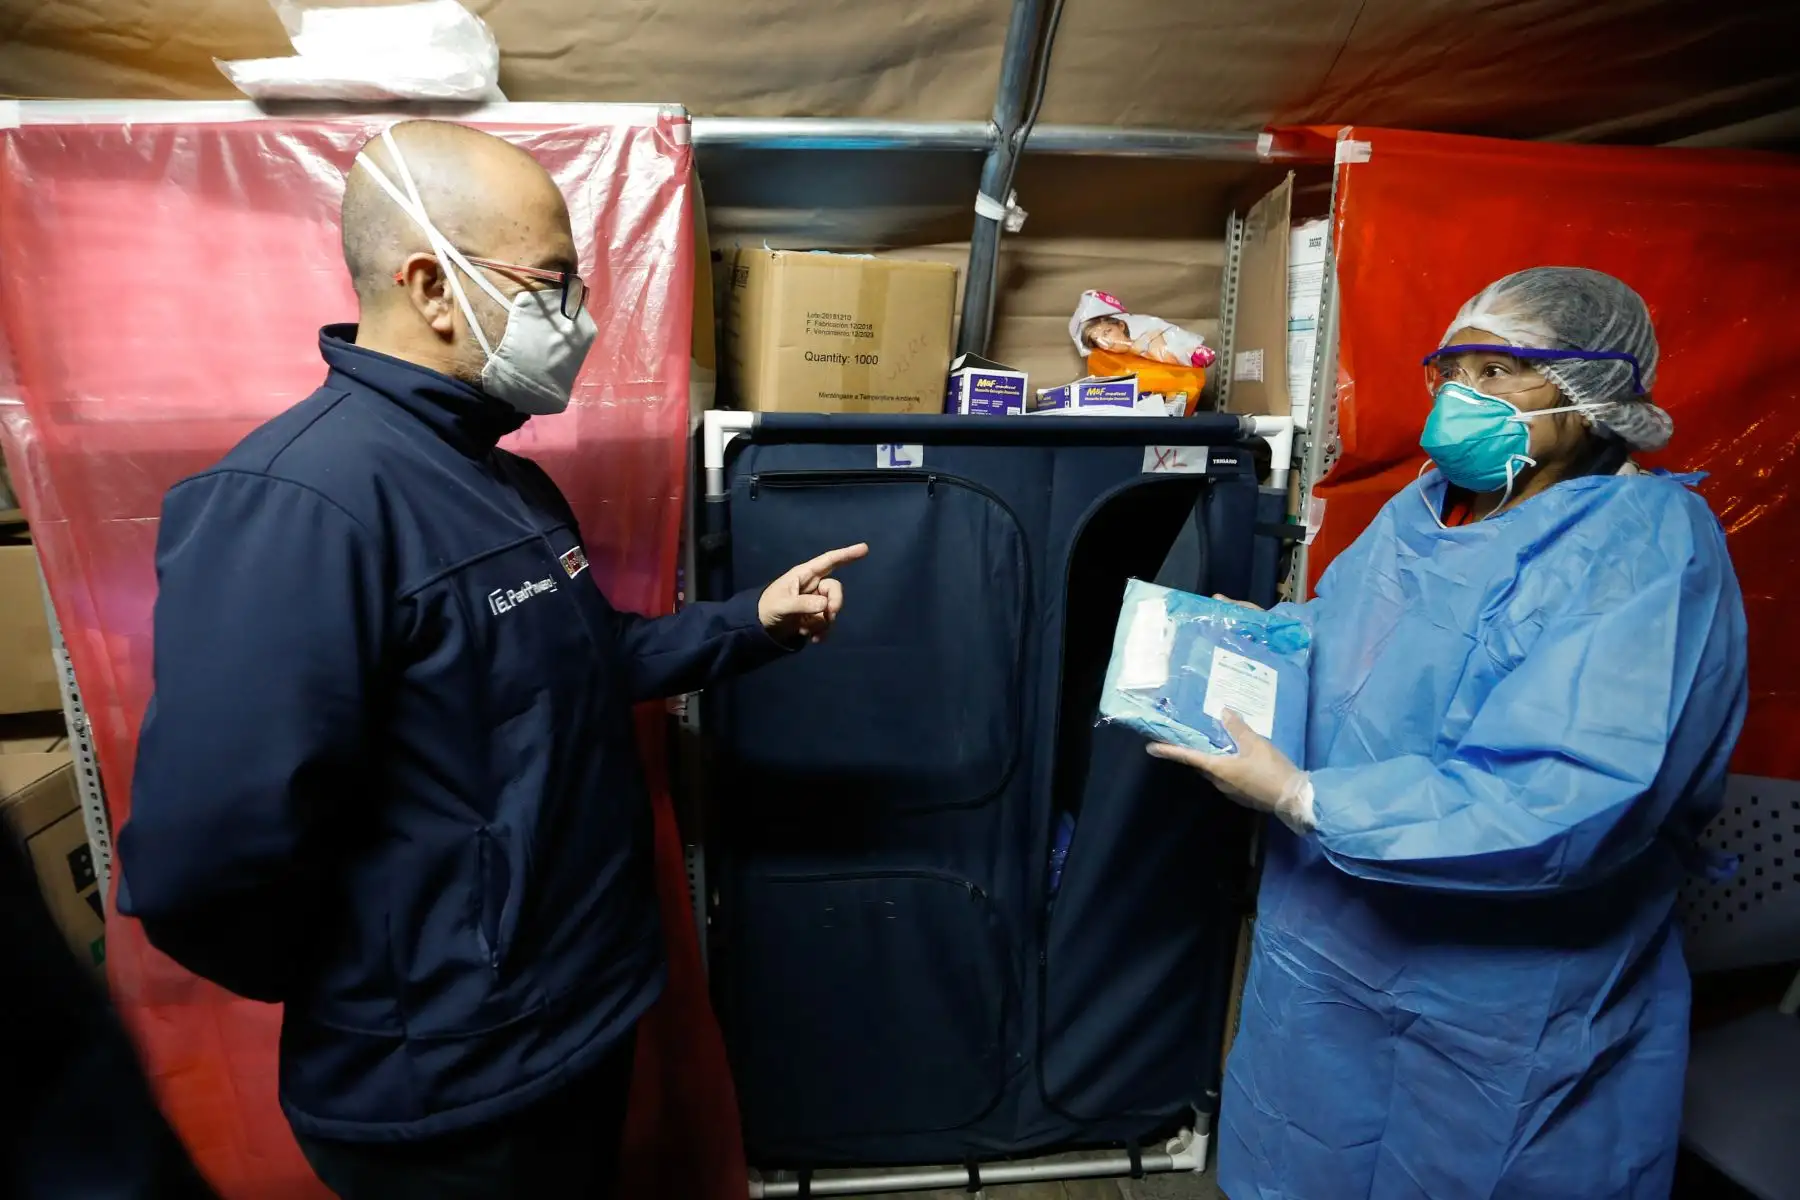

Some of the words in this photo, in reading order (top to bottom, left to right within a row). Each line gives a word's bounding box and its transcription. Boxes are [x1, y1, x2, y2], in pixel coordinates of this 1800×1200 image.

[804, 351, 851, 366] Quantity:
[855, 354, 879, 365] 1000
[1152, 446, 1188, 471] XL
